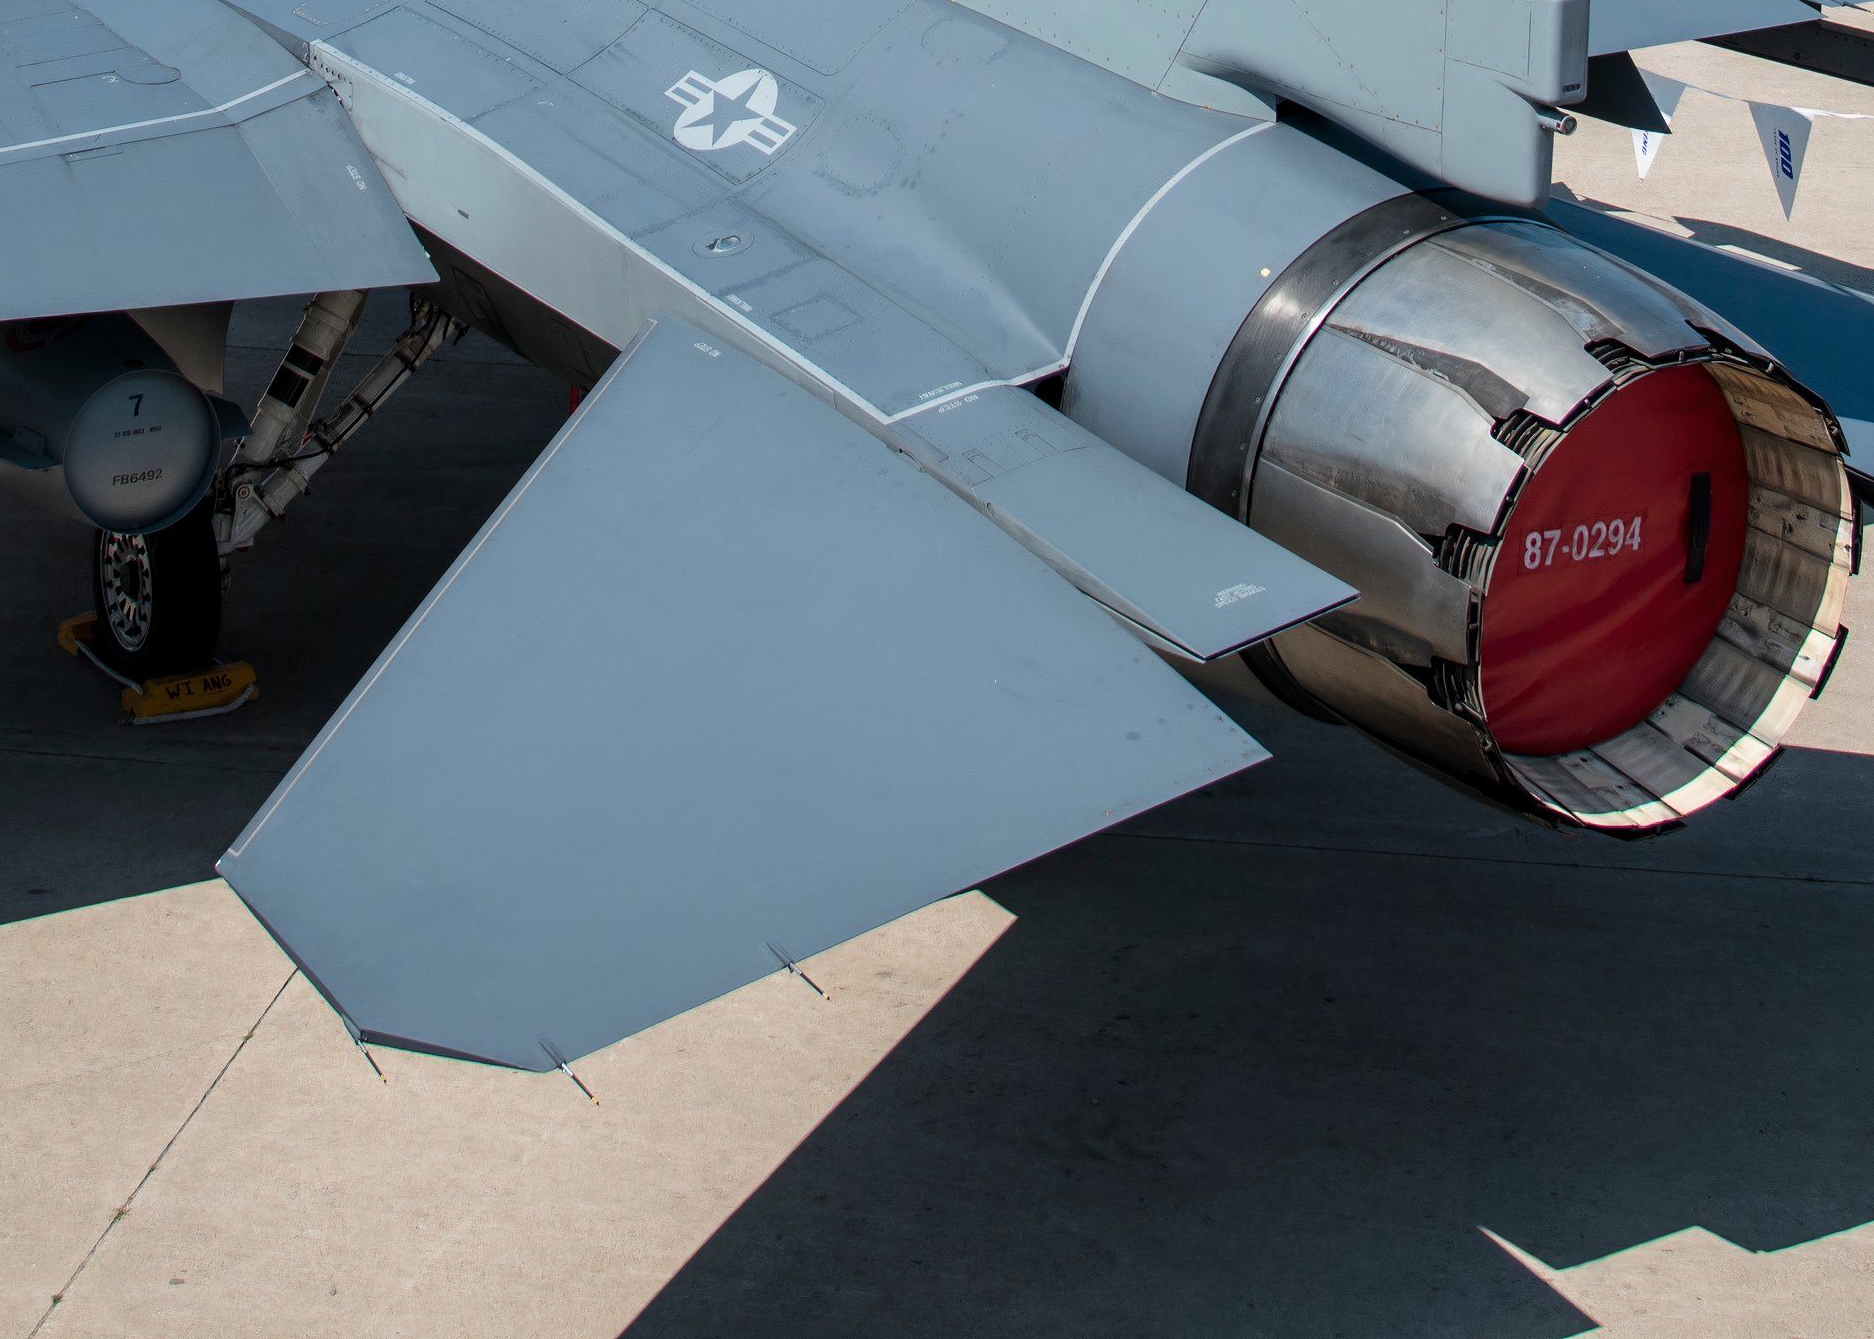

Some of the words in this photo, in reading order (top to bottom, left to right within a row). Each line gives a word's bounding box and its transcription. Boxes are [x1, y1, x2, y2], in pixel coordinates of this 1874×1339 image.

[1776, 129, 1793, 181] 100
[128, 393, 144, 417] 7
[112, 468, 163, 487] FB6492
[1523, 516, 1642, 570] 87-0294
[166, 681, 192, 701] WI
[203, 673, 232, 693] ANG
